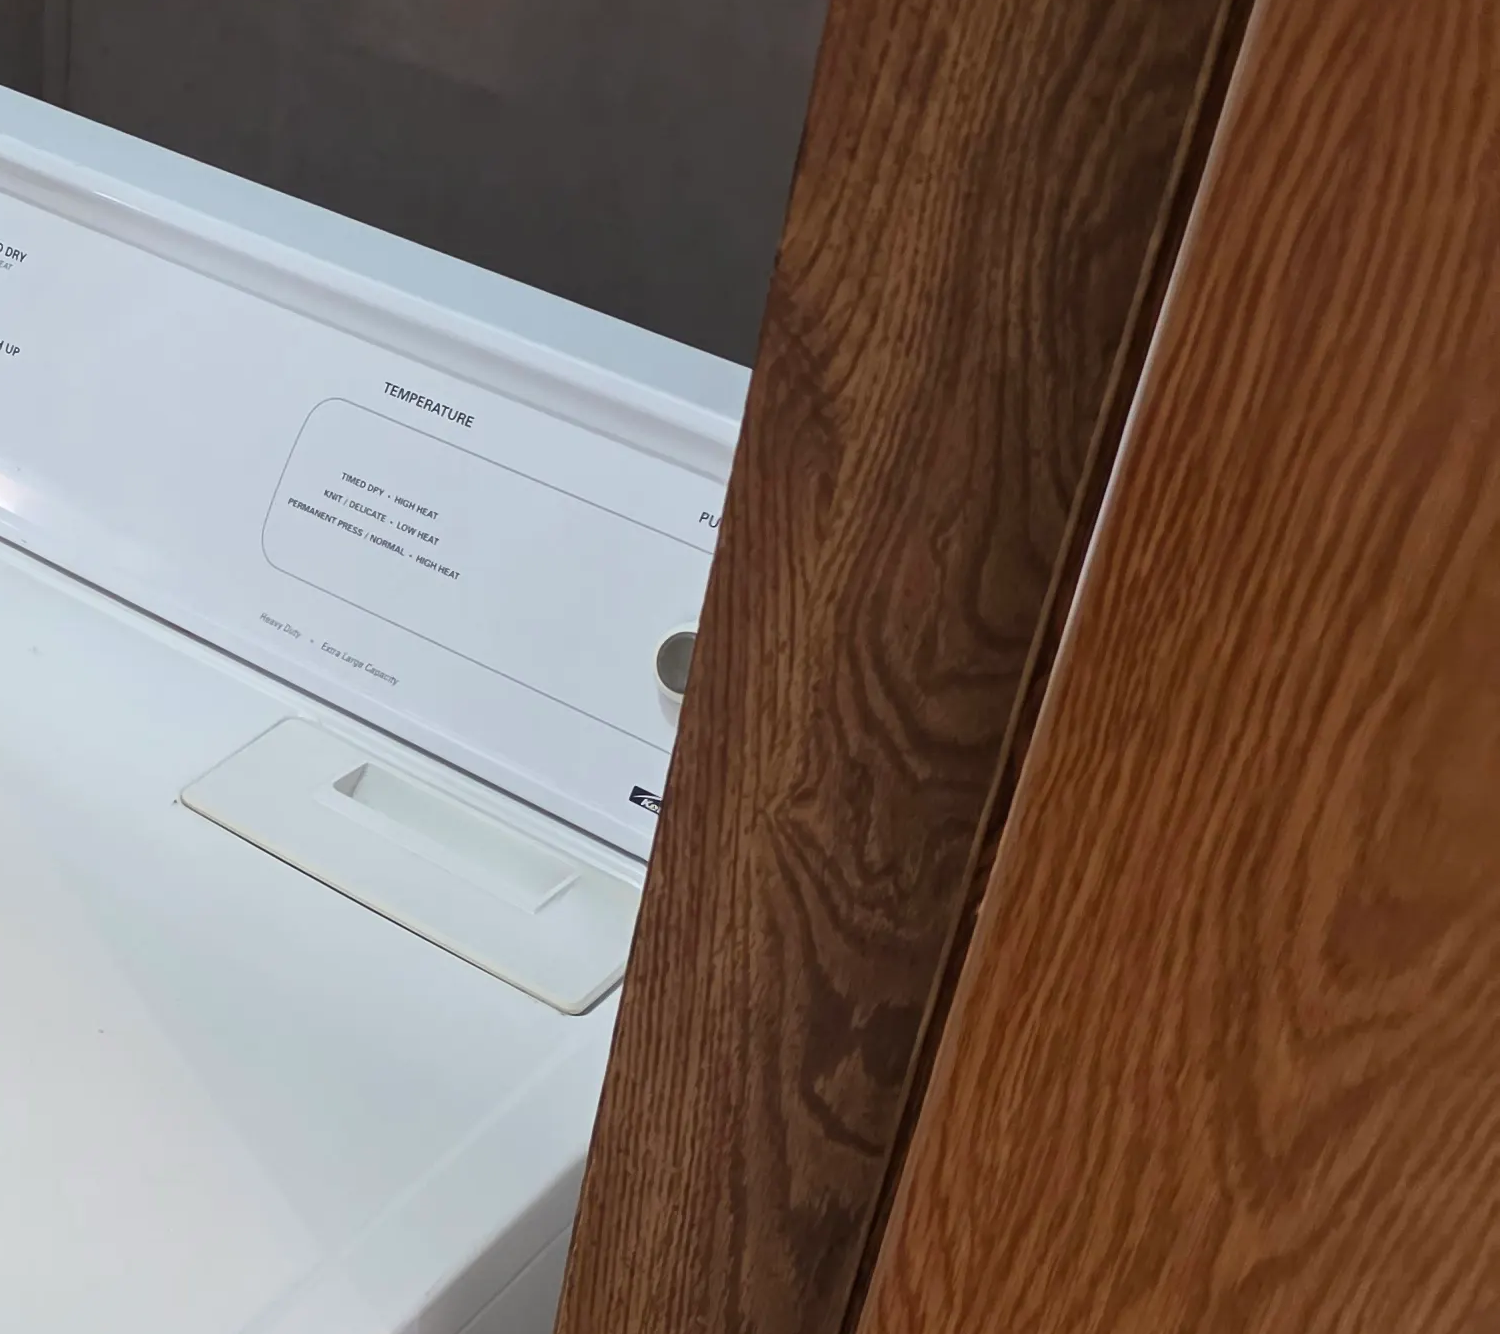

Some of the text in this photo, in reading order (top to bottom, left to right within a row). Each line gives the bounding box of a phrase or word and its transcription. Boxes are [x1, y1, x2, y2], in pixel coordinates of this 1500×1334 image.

[4, 246, 28, 263] DRY
[5, 343, 21, 357] UP
[384, 381, 475, 429] TEMPERATURE
[323, 489, 344, 504] KNIT
[348, 499, 387, 523] DELICATE
[396, 520, 417, 536] LOW
[416, 530, 440, 546] HEAT
[341, 471, 367, 489] TIMED
[394, 495, 417, 511] HIGH
[416, 505, 439, 520] HEAT
[698, 511, 722, 528] PU
[287, 497, 338, 524] PERMANENT
[336, 519, 364, 537] PRESS
[369, 534, 405, 556] NORMAL
[415, 555, 437, 571] HIGH
[437, 565, 460, 581] HEAT
[260, 612, 400, 686] Heavy Duty Extra Large Capacity
[640, 798, 661, 814] Ke
